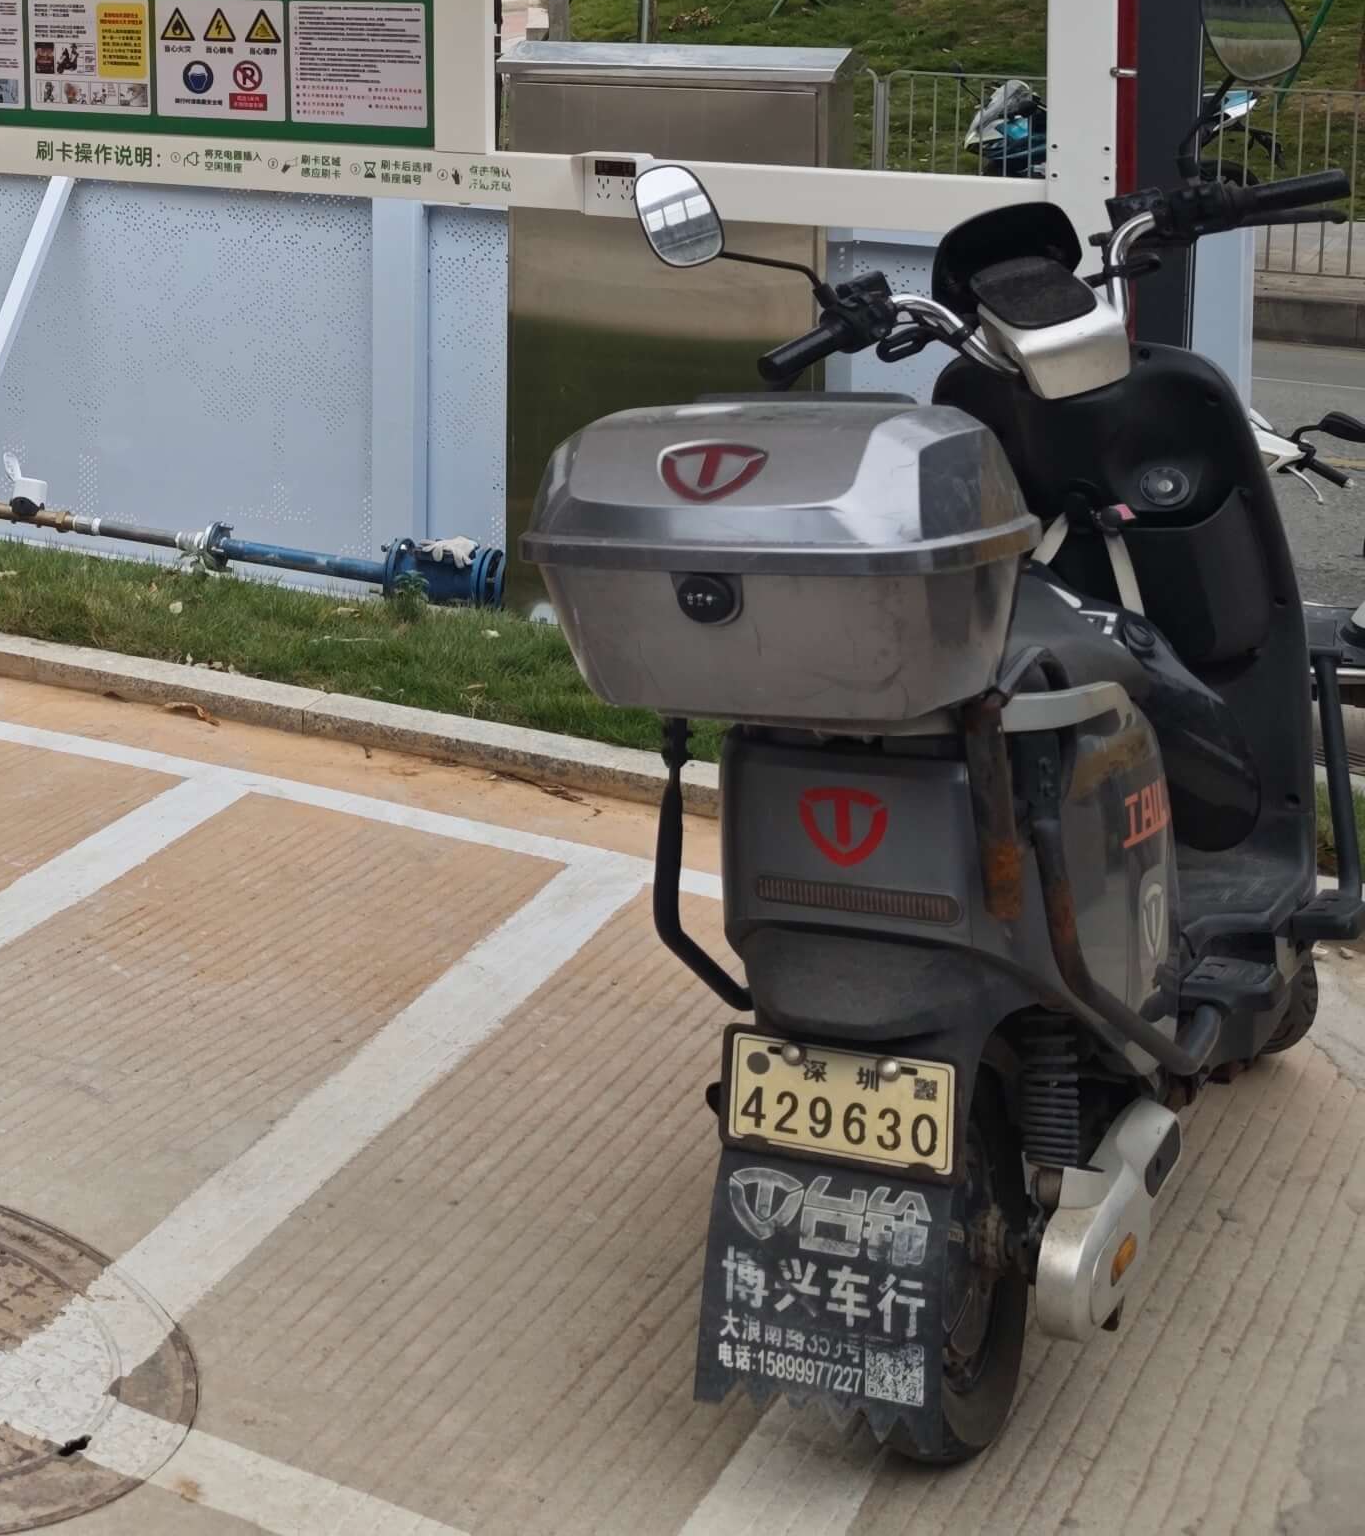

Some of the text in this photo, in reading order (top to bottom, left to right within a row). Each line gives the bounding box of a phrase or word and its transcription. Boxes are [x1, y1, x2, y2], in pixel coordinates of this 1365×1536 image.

[35, 140, 162, 168] 刷卡操作说明:
[204, 149, 263, 162] 将充电器插入
[300, 154, 342, 168] 刷卡区域
[381, 159, 433, 174] 刷卡后选择
[300, 166, 342, 179] 感应刷卡
[802, 1058, 881, 1093] 深圳
[740, 1086, 939, 1158] 429630
[799, 1175, 933, 1266] 台铃
[722, 1246, 927, 1339] 博兴车行
